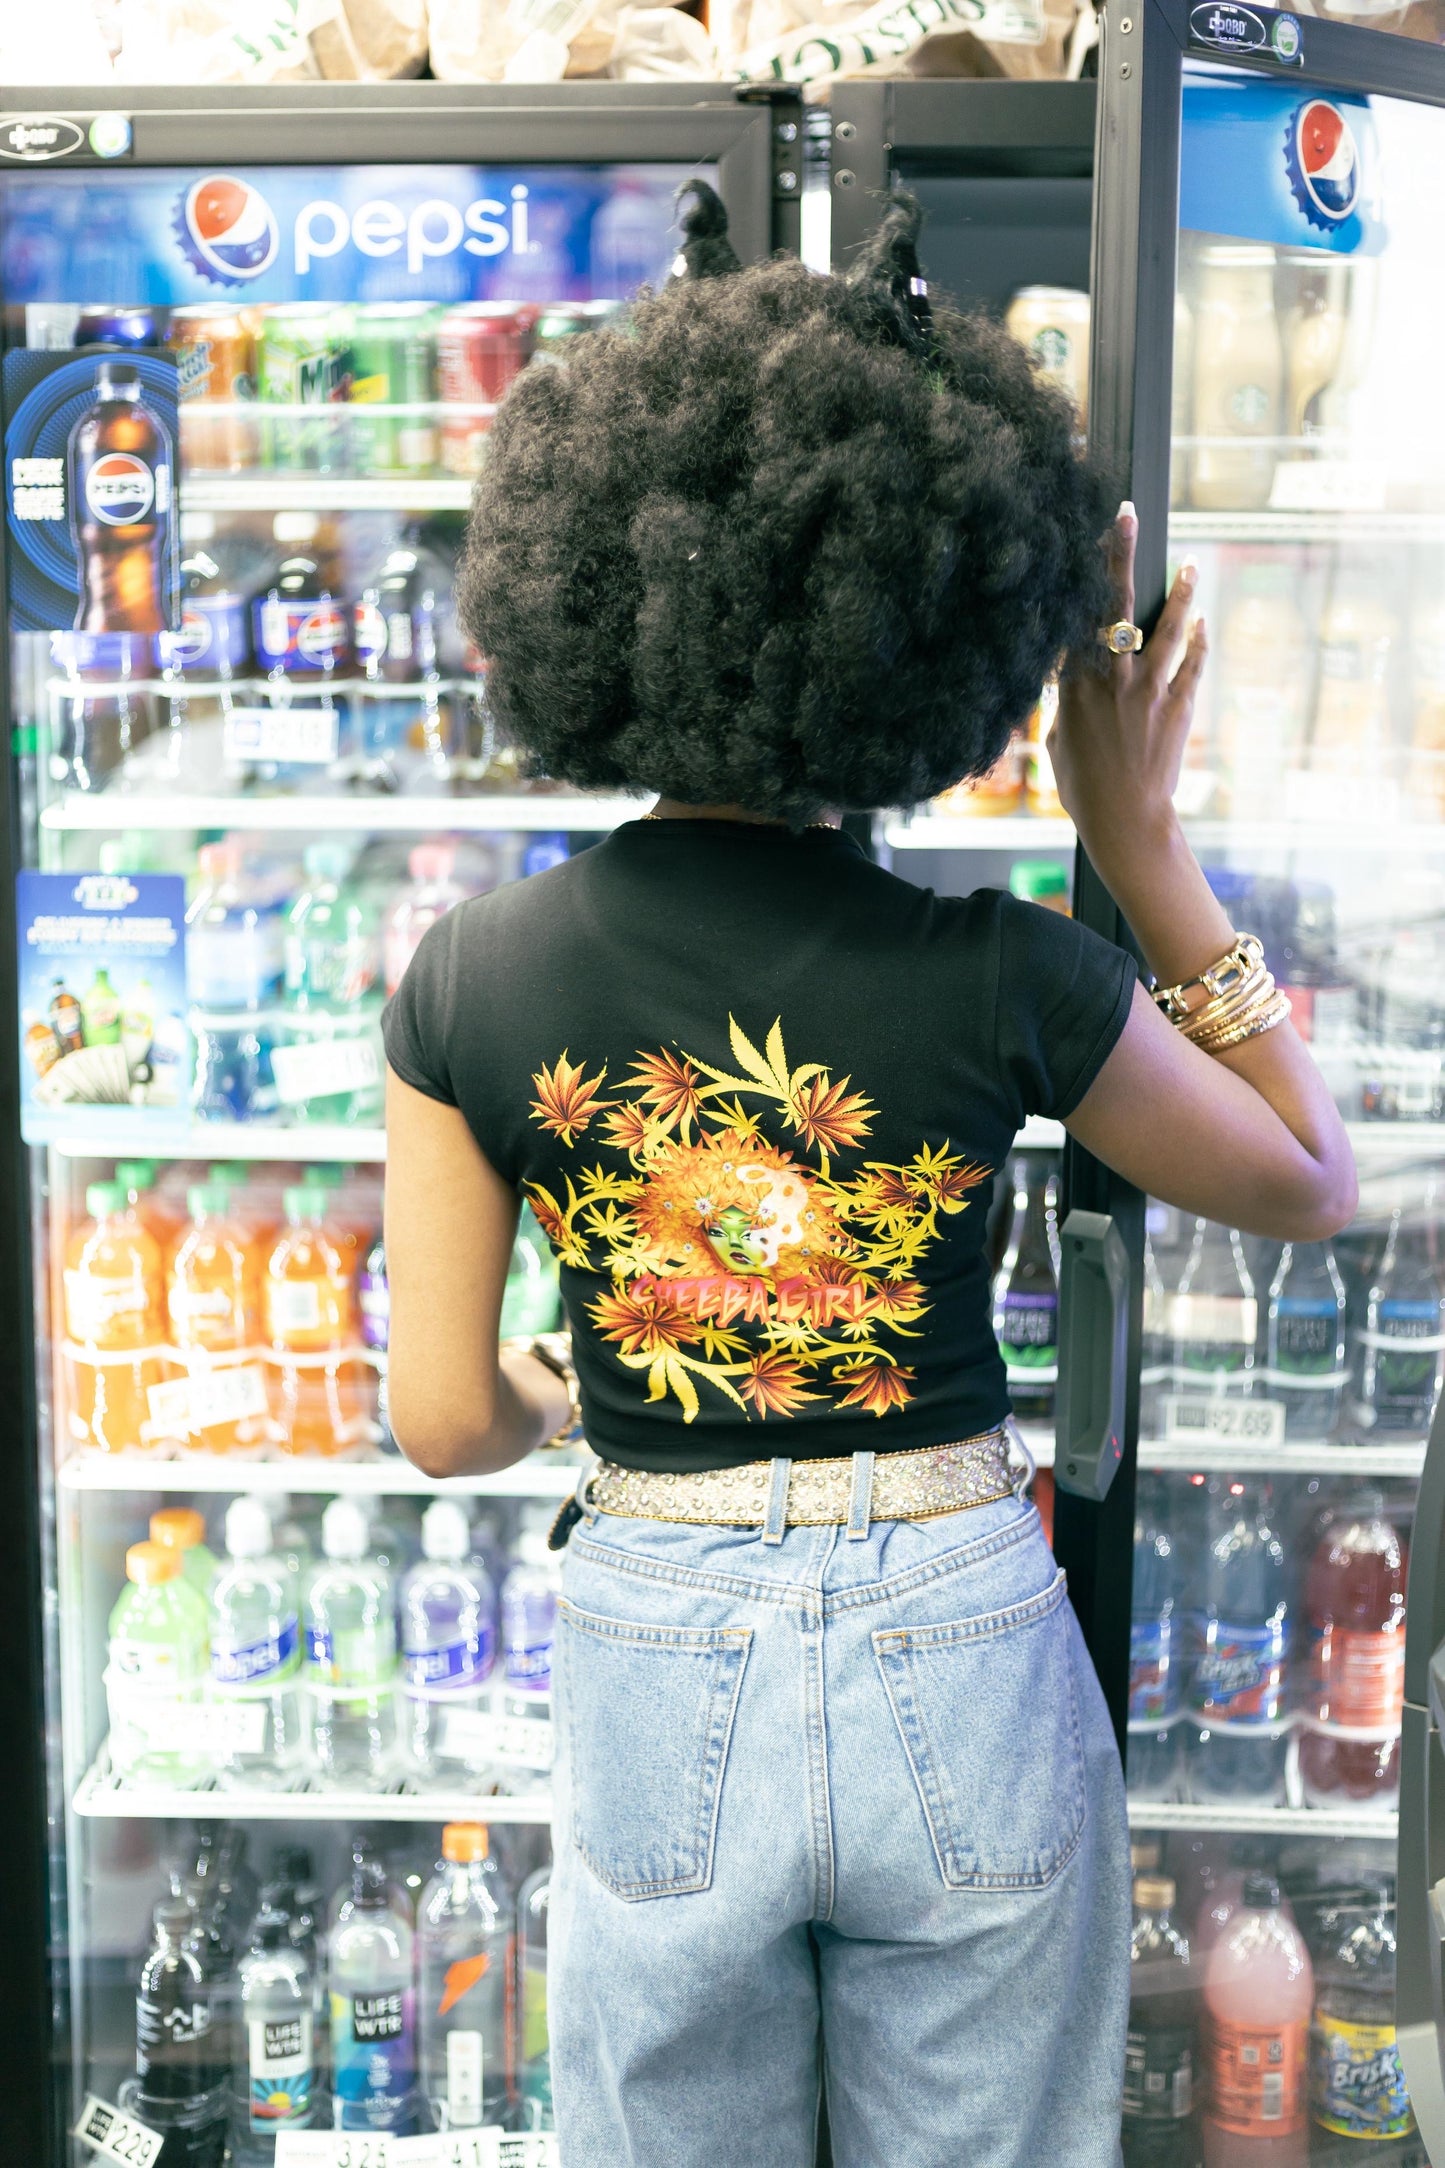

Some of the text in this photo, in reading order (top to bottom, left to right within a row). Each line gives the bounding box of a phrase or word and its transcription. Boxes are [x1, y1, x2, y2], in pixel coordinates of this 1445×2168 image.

[295, 184, 529, 276] pepsi
[630, 1271, 884, 1330] CHEEBA GIRL
[354, 1994, 402, 2017] LIFE
[265, 2022, 301, 2042] LIFE
[354, 2013, 402, 2037] WTR
[265, 2037, 301, 2057] WTR
